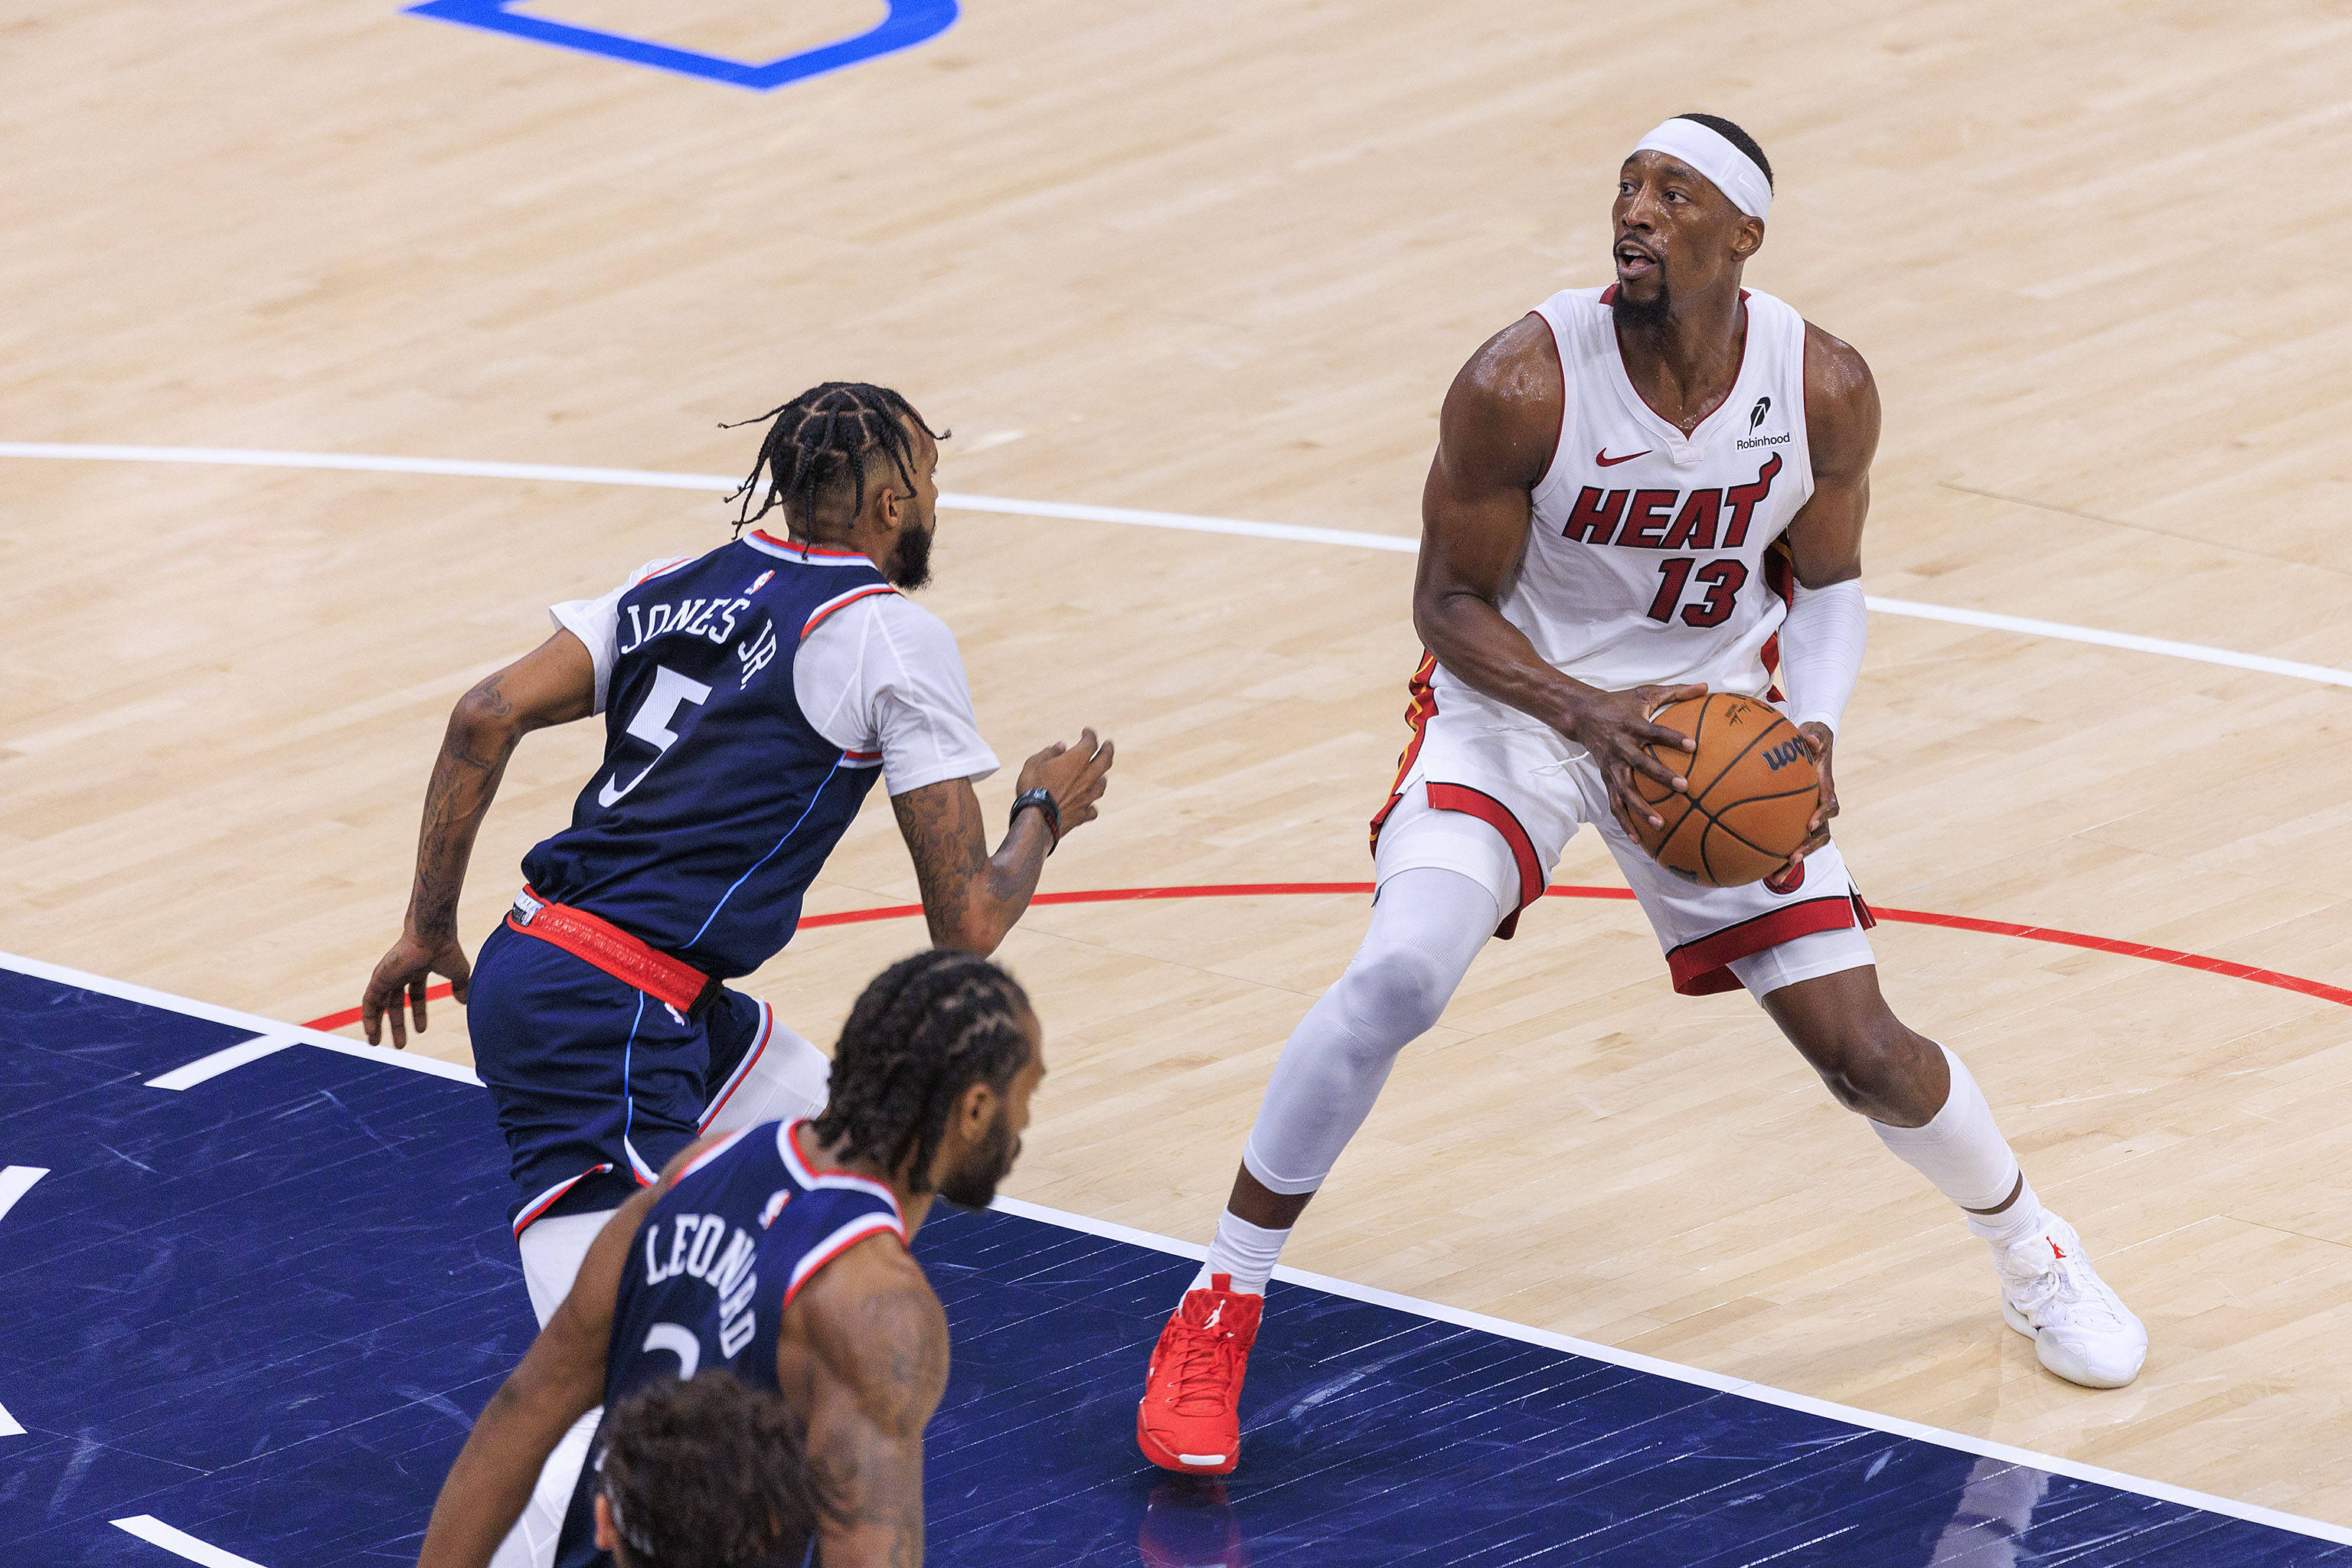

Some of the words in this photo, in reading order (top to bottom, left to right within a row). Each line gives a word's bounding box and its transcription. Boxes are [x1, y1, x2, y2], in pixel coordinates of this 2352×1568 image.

[1736, 432, 1790, 450] Robinhood
[1562, 452, 1783, 550] HEAT
[1647, 557, 1749, 628] 13
[621, 598, 750, 654] JONES
[598, 665, 713, 808] 5
[1760, 733, 1814, 773] lson
